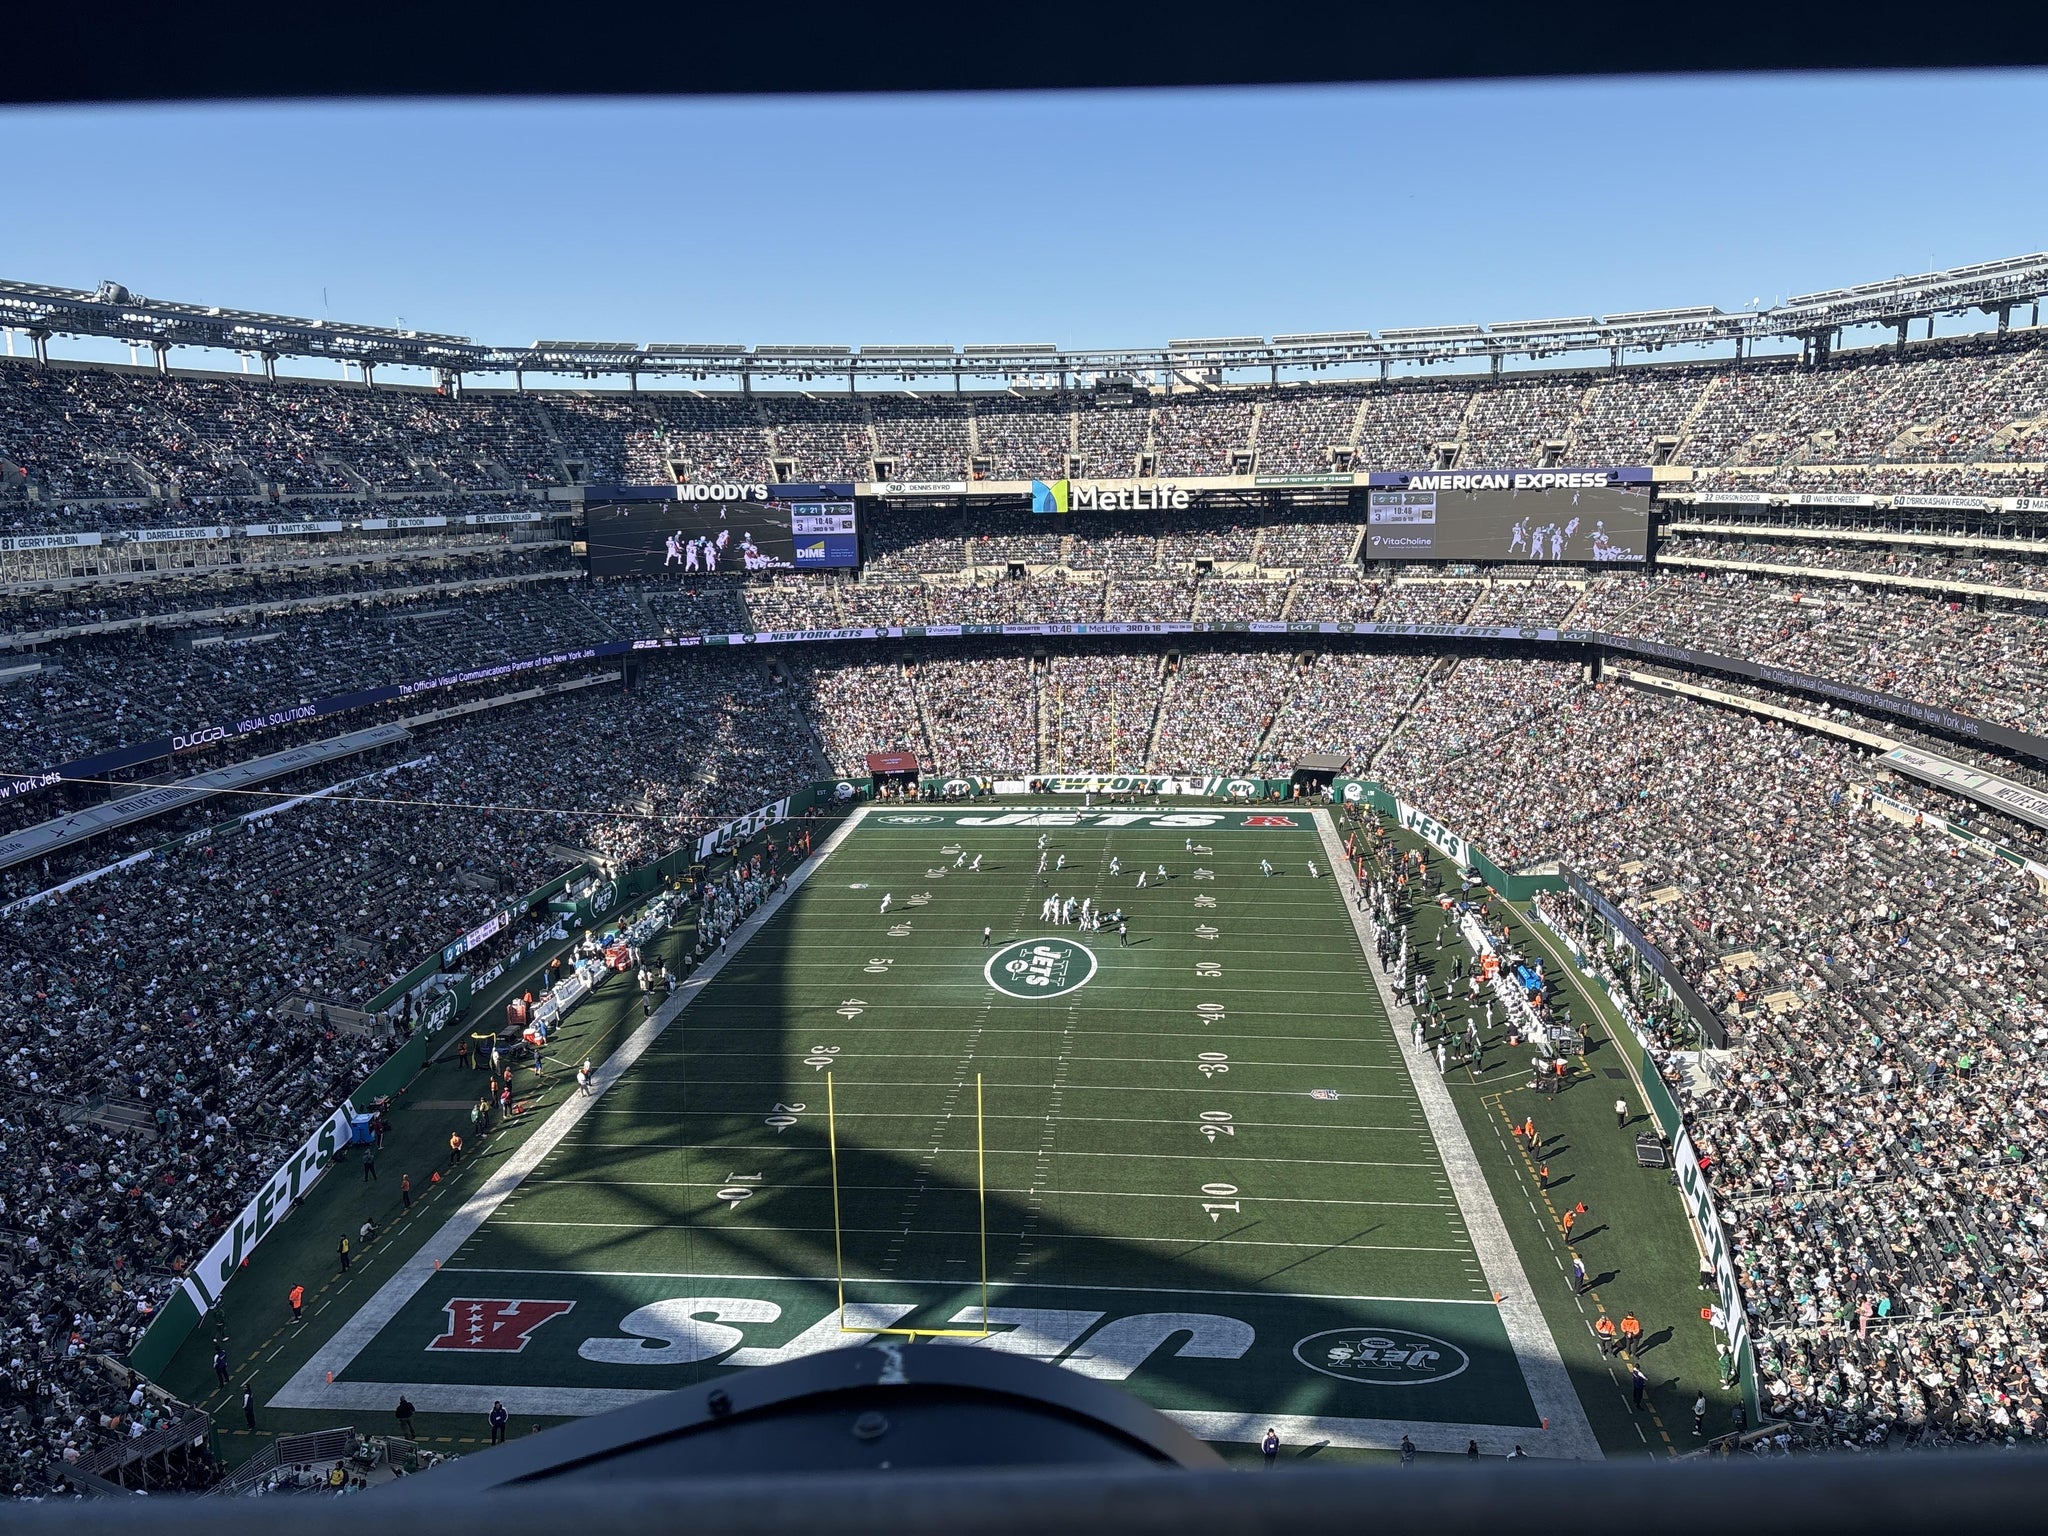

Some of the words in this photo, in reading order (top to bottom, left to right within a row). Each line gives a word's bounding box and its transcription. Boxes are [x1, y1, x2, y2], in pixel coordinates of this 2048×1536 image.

[890, 483, 905, 493] 90
[932, 484, 951, 492] BYRD
[1408, 474, 1509, 490] AMERICAN
[1514, 472, 1608, 488] EXPRESS
[677, 484, 768, 500] MOODY'S
[1072, 484, 1190, 511] MetLife
[1801, 494, 1811, 503] 80
[1814, 495, 1833, 503] WAYNE
[1893, 495, 1905, 505] 60
[2016, 499, 2029, 509] 99
[387, 519, 398, 528] 88
[400, 519, 409, 527] AL
[409, 518, 425, 526] TOON
[476, 514, 486, 523] 85
[488, 514, 510, 522] WESLEY
[510, 513, 532, 521] WALKER
[126, 531, 140, 541] 24
[146, 530, 185, 541] DARRELLE
[185, 529, 206, 539] REVIS
[268, 524, 279, 534] 41
[281, 524, 301, 533] MATT
[301, 523, 321, 532] SNELL
[1, 538, 15, 550] 81
[18, 537, 45, 548] GERRY
[47, 535, 78, 546] PHILBIN
[796, 549, 826, 558] DIME
[770, 633, 797, 641] NEW
[800, 631, 831, 640] YORK
[833, 630, 863, 638] JETS
[1049, 625, 1072, 633] 10:46
[1089, 625, 1121, 633] MetLife
[1374, 625, 1411, 633] NEW
[1414, 626, 1457, 635] YORK
[1459, 627, 1502, 637] JETS
[1636, 641, 1656, 652] VISUAL
[1657, 644, 1691, 661] SOLUTIONS
[398, 684, 412, 696] The
[413, 678, 437, 693] Official
[438, 674, 458, 688] Visual
[459, 665, 511, 683] Communications
[512, 659, 533, 672] Partner
[535, 658, 542, 667] of
[542, 657, 552, 666] the
[553, 654, 567, 664] New
[568, 651, 582, 661] York
[582, 649, 595, 659] Jets
[1760, 667, 1771, 680] The
[1772, 670, 1795, 685] Official
[1796, 676, 1816, 690] Visual
[1817, 681, 1872, 704] Communications
[1873, 691, 1901, 713] Partner
[1902, 700, 1910, 714] of
[1911, 704, 1922, 718] the
[1924, 708, 1940, 723] New
[1942, 712, 1960, 729] York
[1961, 718, 1979, 735] Jets
[172, 726, 233, 750] DUGGAL
[236, 716, 268, 733] VISUAL
[269, 704, 316, 726] SOLUTIONS
[12, 778, 38, 795] York
[39, 771, 61, 788] Jets
[955, 813, 1226, 827] JETS
[1406, 811, 1460, 858] J-E-T-S
[1194, 896, 1217, 908] 30
[1195, 927, 1219, 940] 40
[455, 942, 463, 956] 21
[864, 958, 893, 973] 50
[1025, 946, 1061, 986] JETS
[1195, 962, 1222, 977] 50
[427, 1002, 451, 1029] JETS
[836, 999, 868, 1016] 40
[1197, 1003, 1226, 1021] 40
[804, 1045, 840, 1066] 30
[1198, 1052, 1229, 1073] 30
[764, 1102, 806, 1126] 20
[1200, 1111, 1235, 1136] 20
[716, 1171, 763, 1201] 10
[220, 1120, 336, 1282] J-E-T-S
[1201, 1182, 1240, 1213] 10
[1683, 1164, 1734, 1322] J-E-T-S
[577, 1298, 1256, 1381] JETS
[1328, 1347, 1441, 1366] JETS
[360, 1446, 368, 1458] 12
